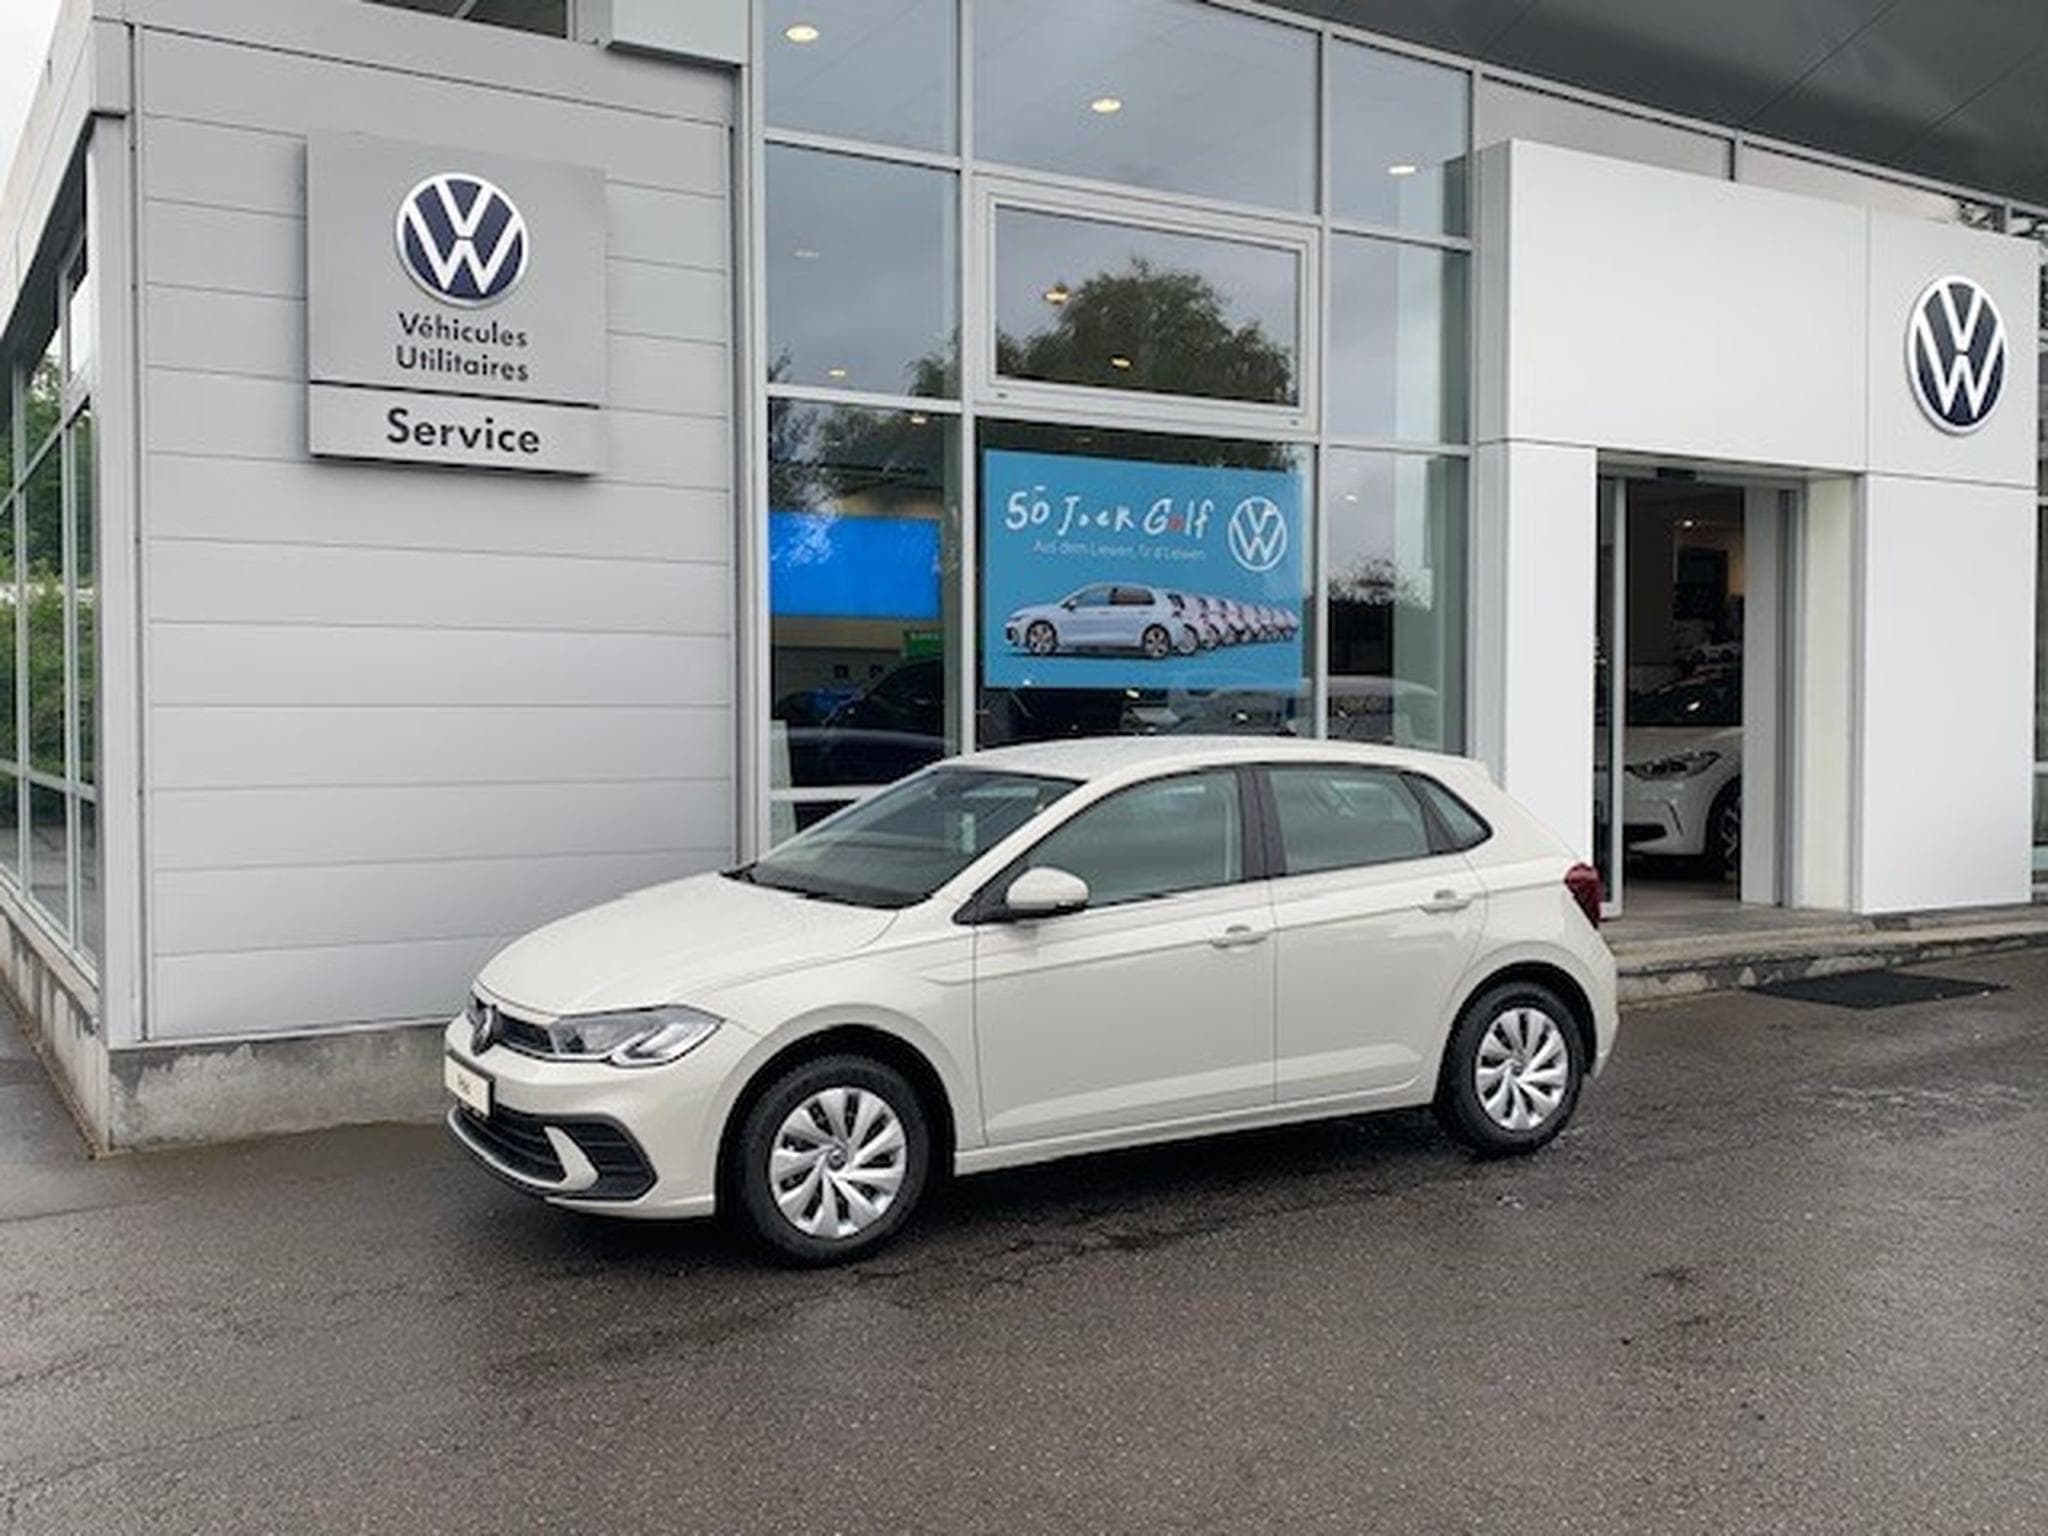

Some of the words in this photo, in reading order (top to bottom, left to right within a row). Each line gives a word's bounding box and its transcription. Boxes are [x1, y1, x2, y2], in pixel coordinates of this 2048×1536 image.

[398, 312, 528, 347] Véhicules
[396, 345, 528, 382] Utilitaires
[386, 408, 540, 453] Service
[1005, 486, 1049, 531] 50
[1143, 498, 1215, 539] Golf
